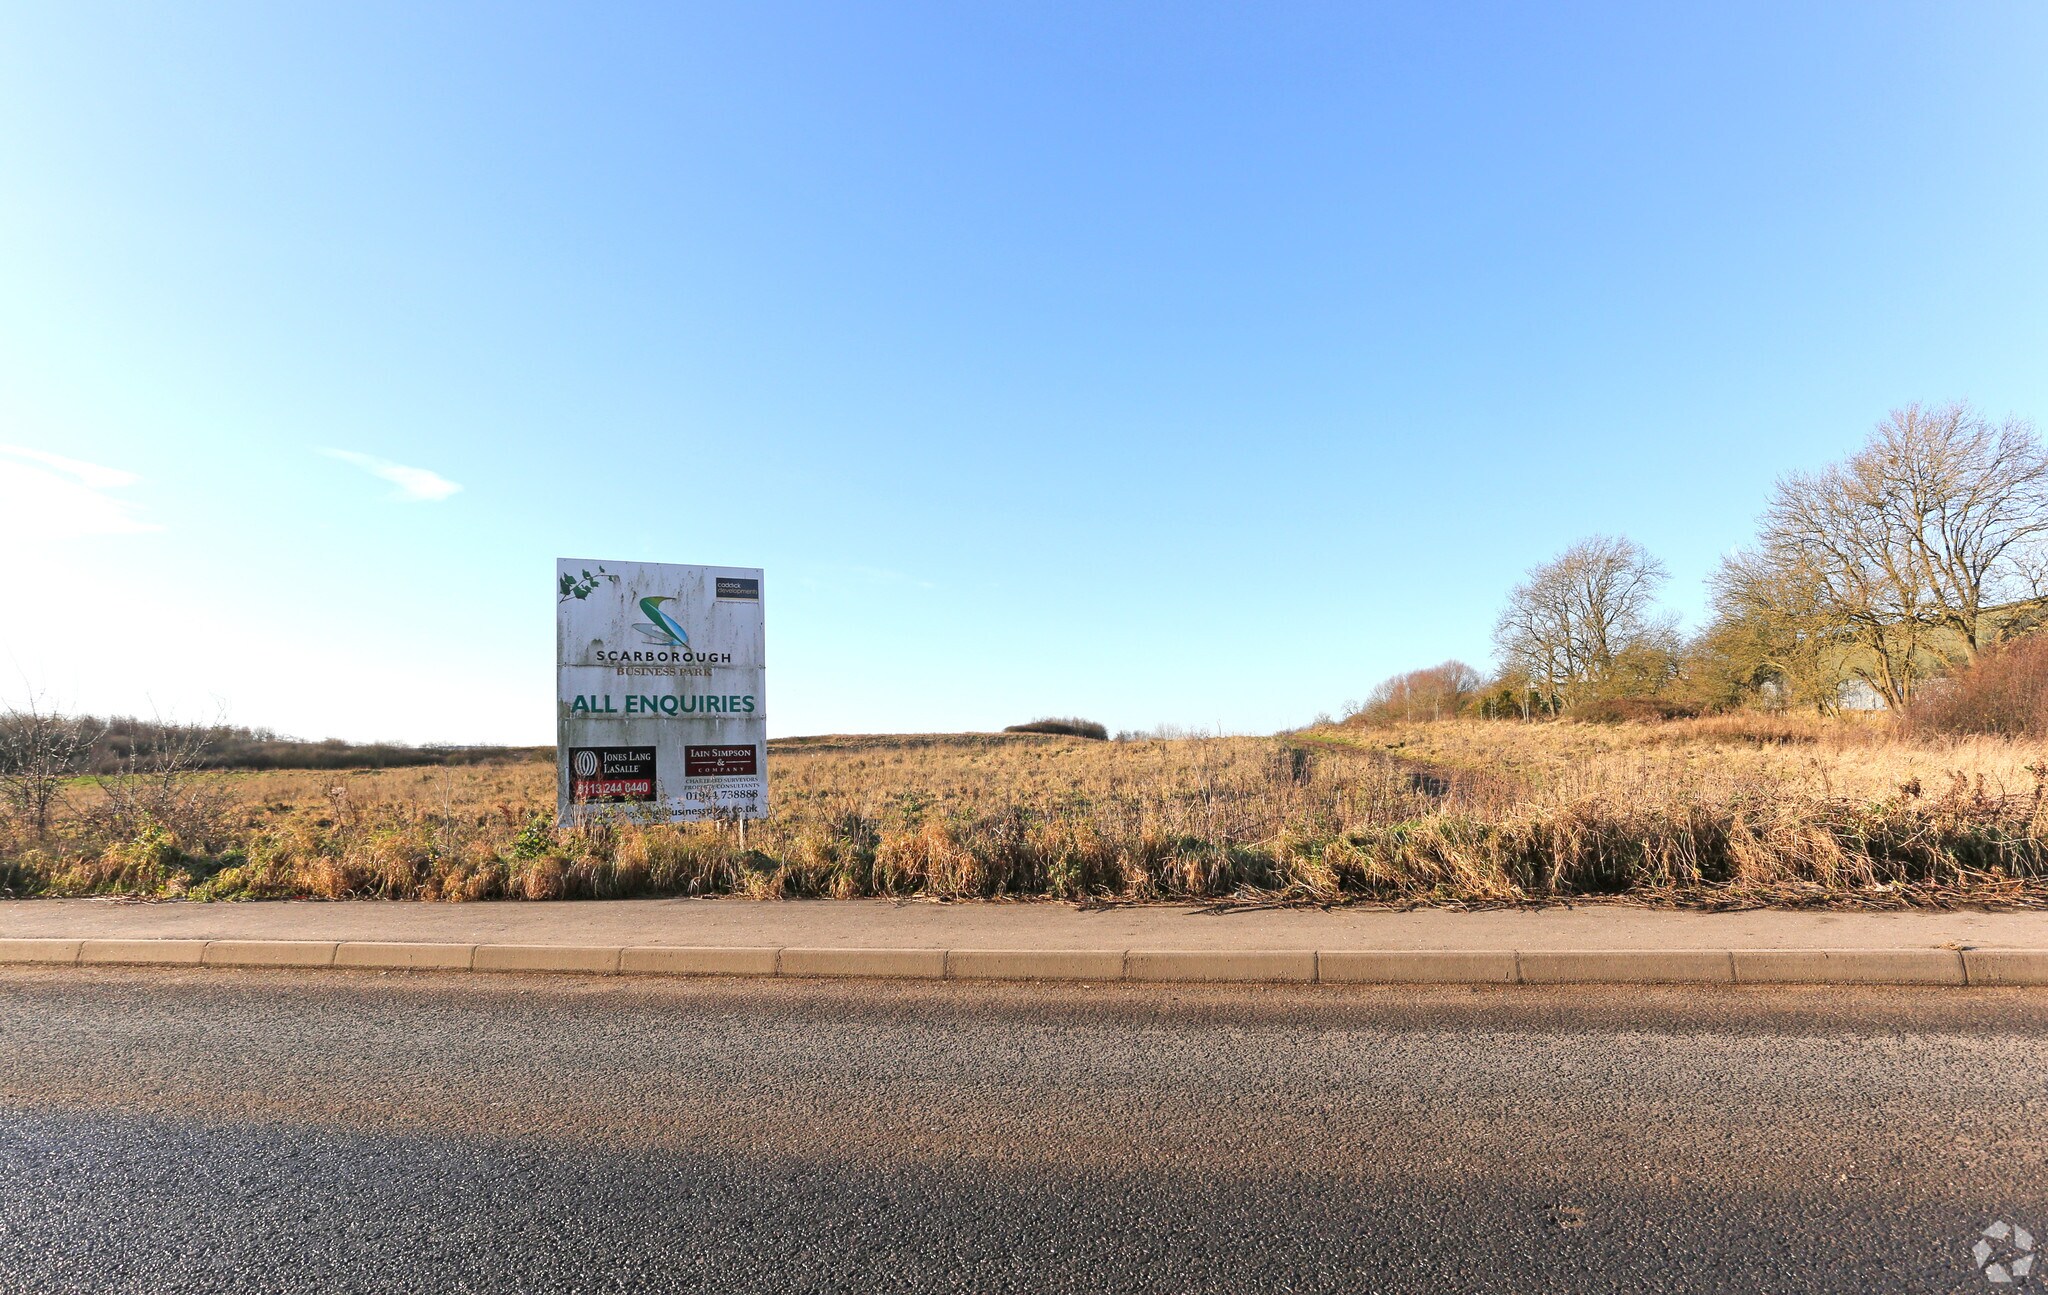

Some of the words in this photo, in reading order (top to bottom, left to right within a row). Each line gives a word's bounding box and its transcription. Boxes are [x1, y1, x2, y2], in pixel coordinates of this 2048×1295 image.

[596, 650, 731, 663] SCARBOROUGH
[616, 666, 676, 677] BUSINESS
[679, 667, 713, 677] PARK
[571, 695, 618, 713] ALL
[625, 695, 755, 717] ENQUIRIES
[604, 752, 627, 763] JONES
[629, 752, 651, 761] LANG
[691, 749, 710, 757] IAIN
[712, 749, 750, 757] SIMPSON
